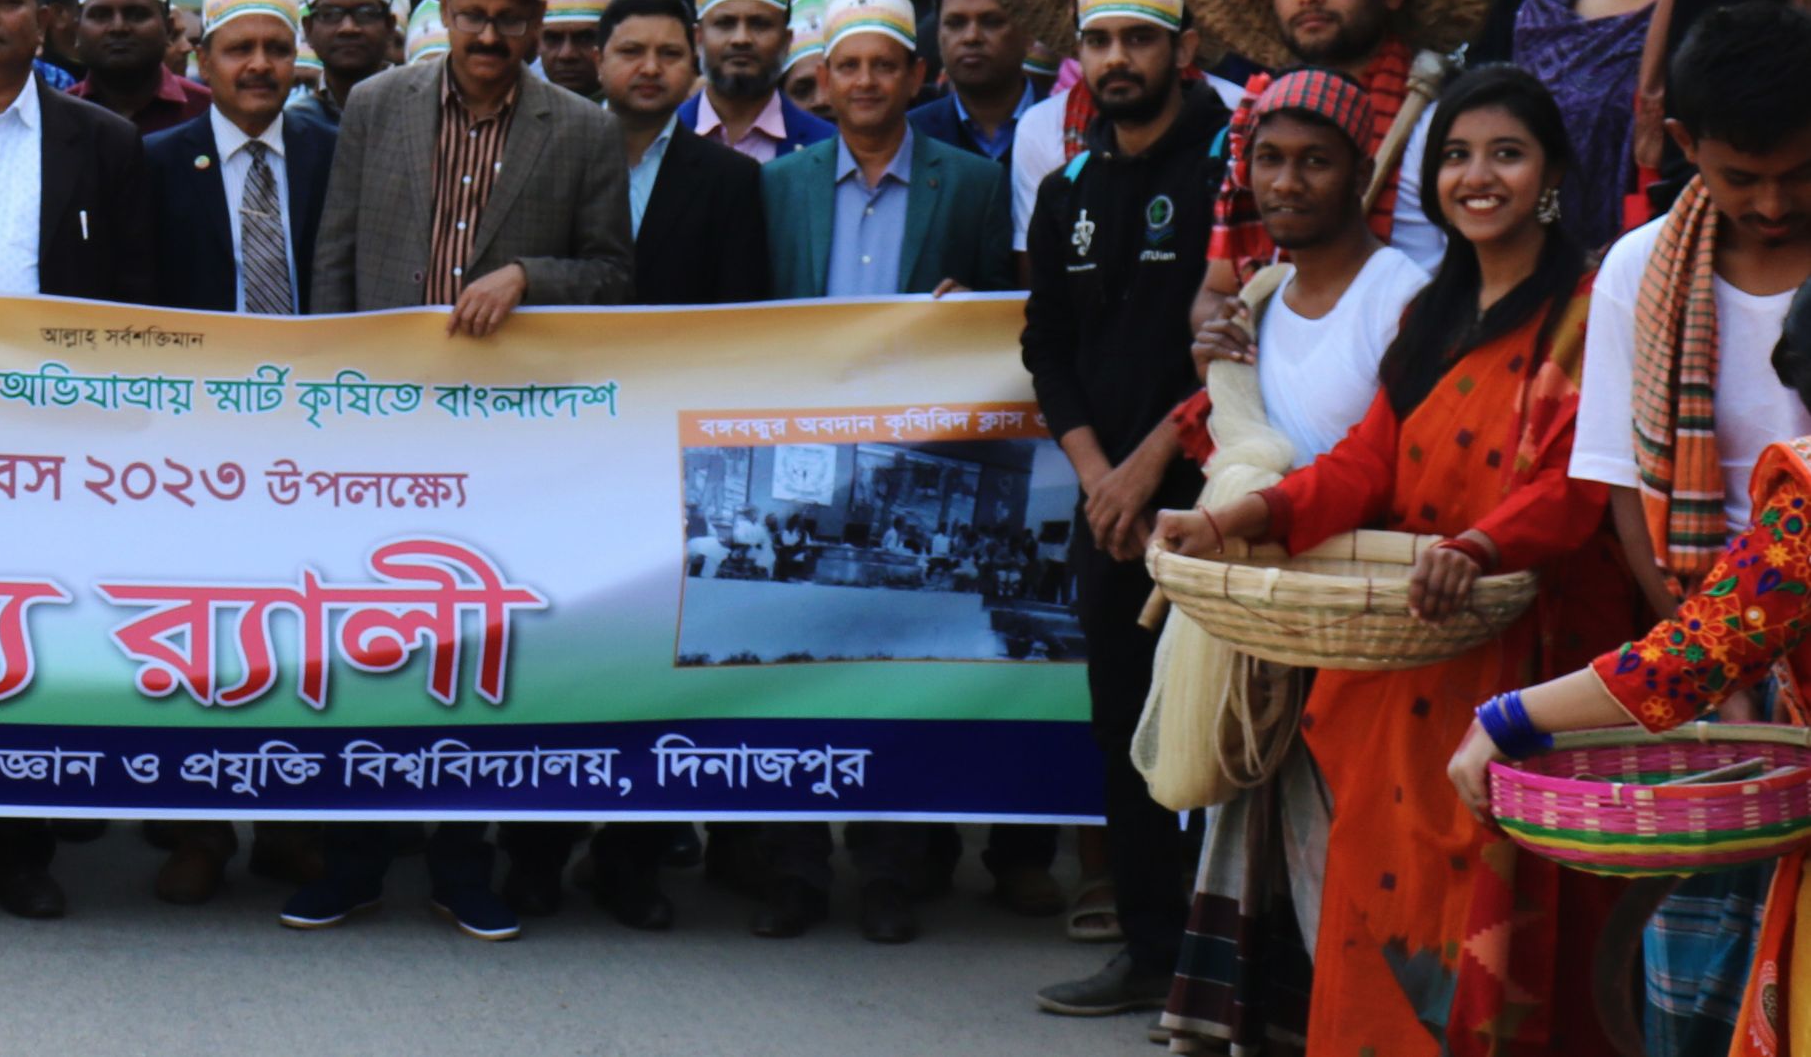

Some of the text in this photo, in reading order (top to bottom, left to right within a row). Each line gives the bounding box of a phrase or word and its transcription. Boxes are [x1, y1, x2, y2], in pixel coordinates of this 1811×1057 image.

[103, 325, 206, 350] সর্বশক্তিমান
[204, 365, 289, 415] স্মার্ট
[296, 370, 423, 428] কৃষিতে
[435, 380, 618, 419] বাংলাদেশ
[793, 414, 876, 437] অবদান
[883, 406, 971, 440] কৃষিবিদ
[84, 456, 246, 508] ২০২৩
[265, 459, 469, 509] উপলক্ষ্যে
[121, 752, 160, 784] ও
[180, 741, 326, 797] প্রযুক্তি
[650, 733, 872, 798] দিনাজপুর
